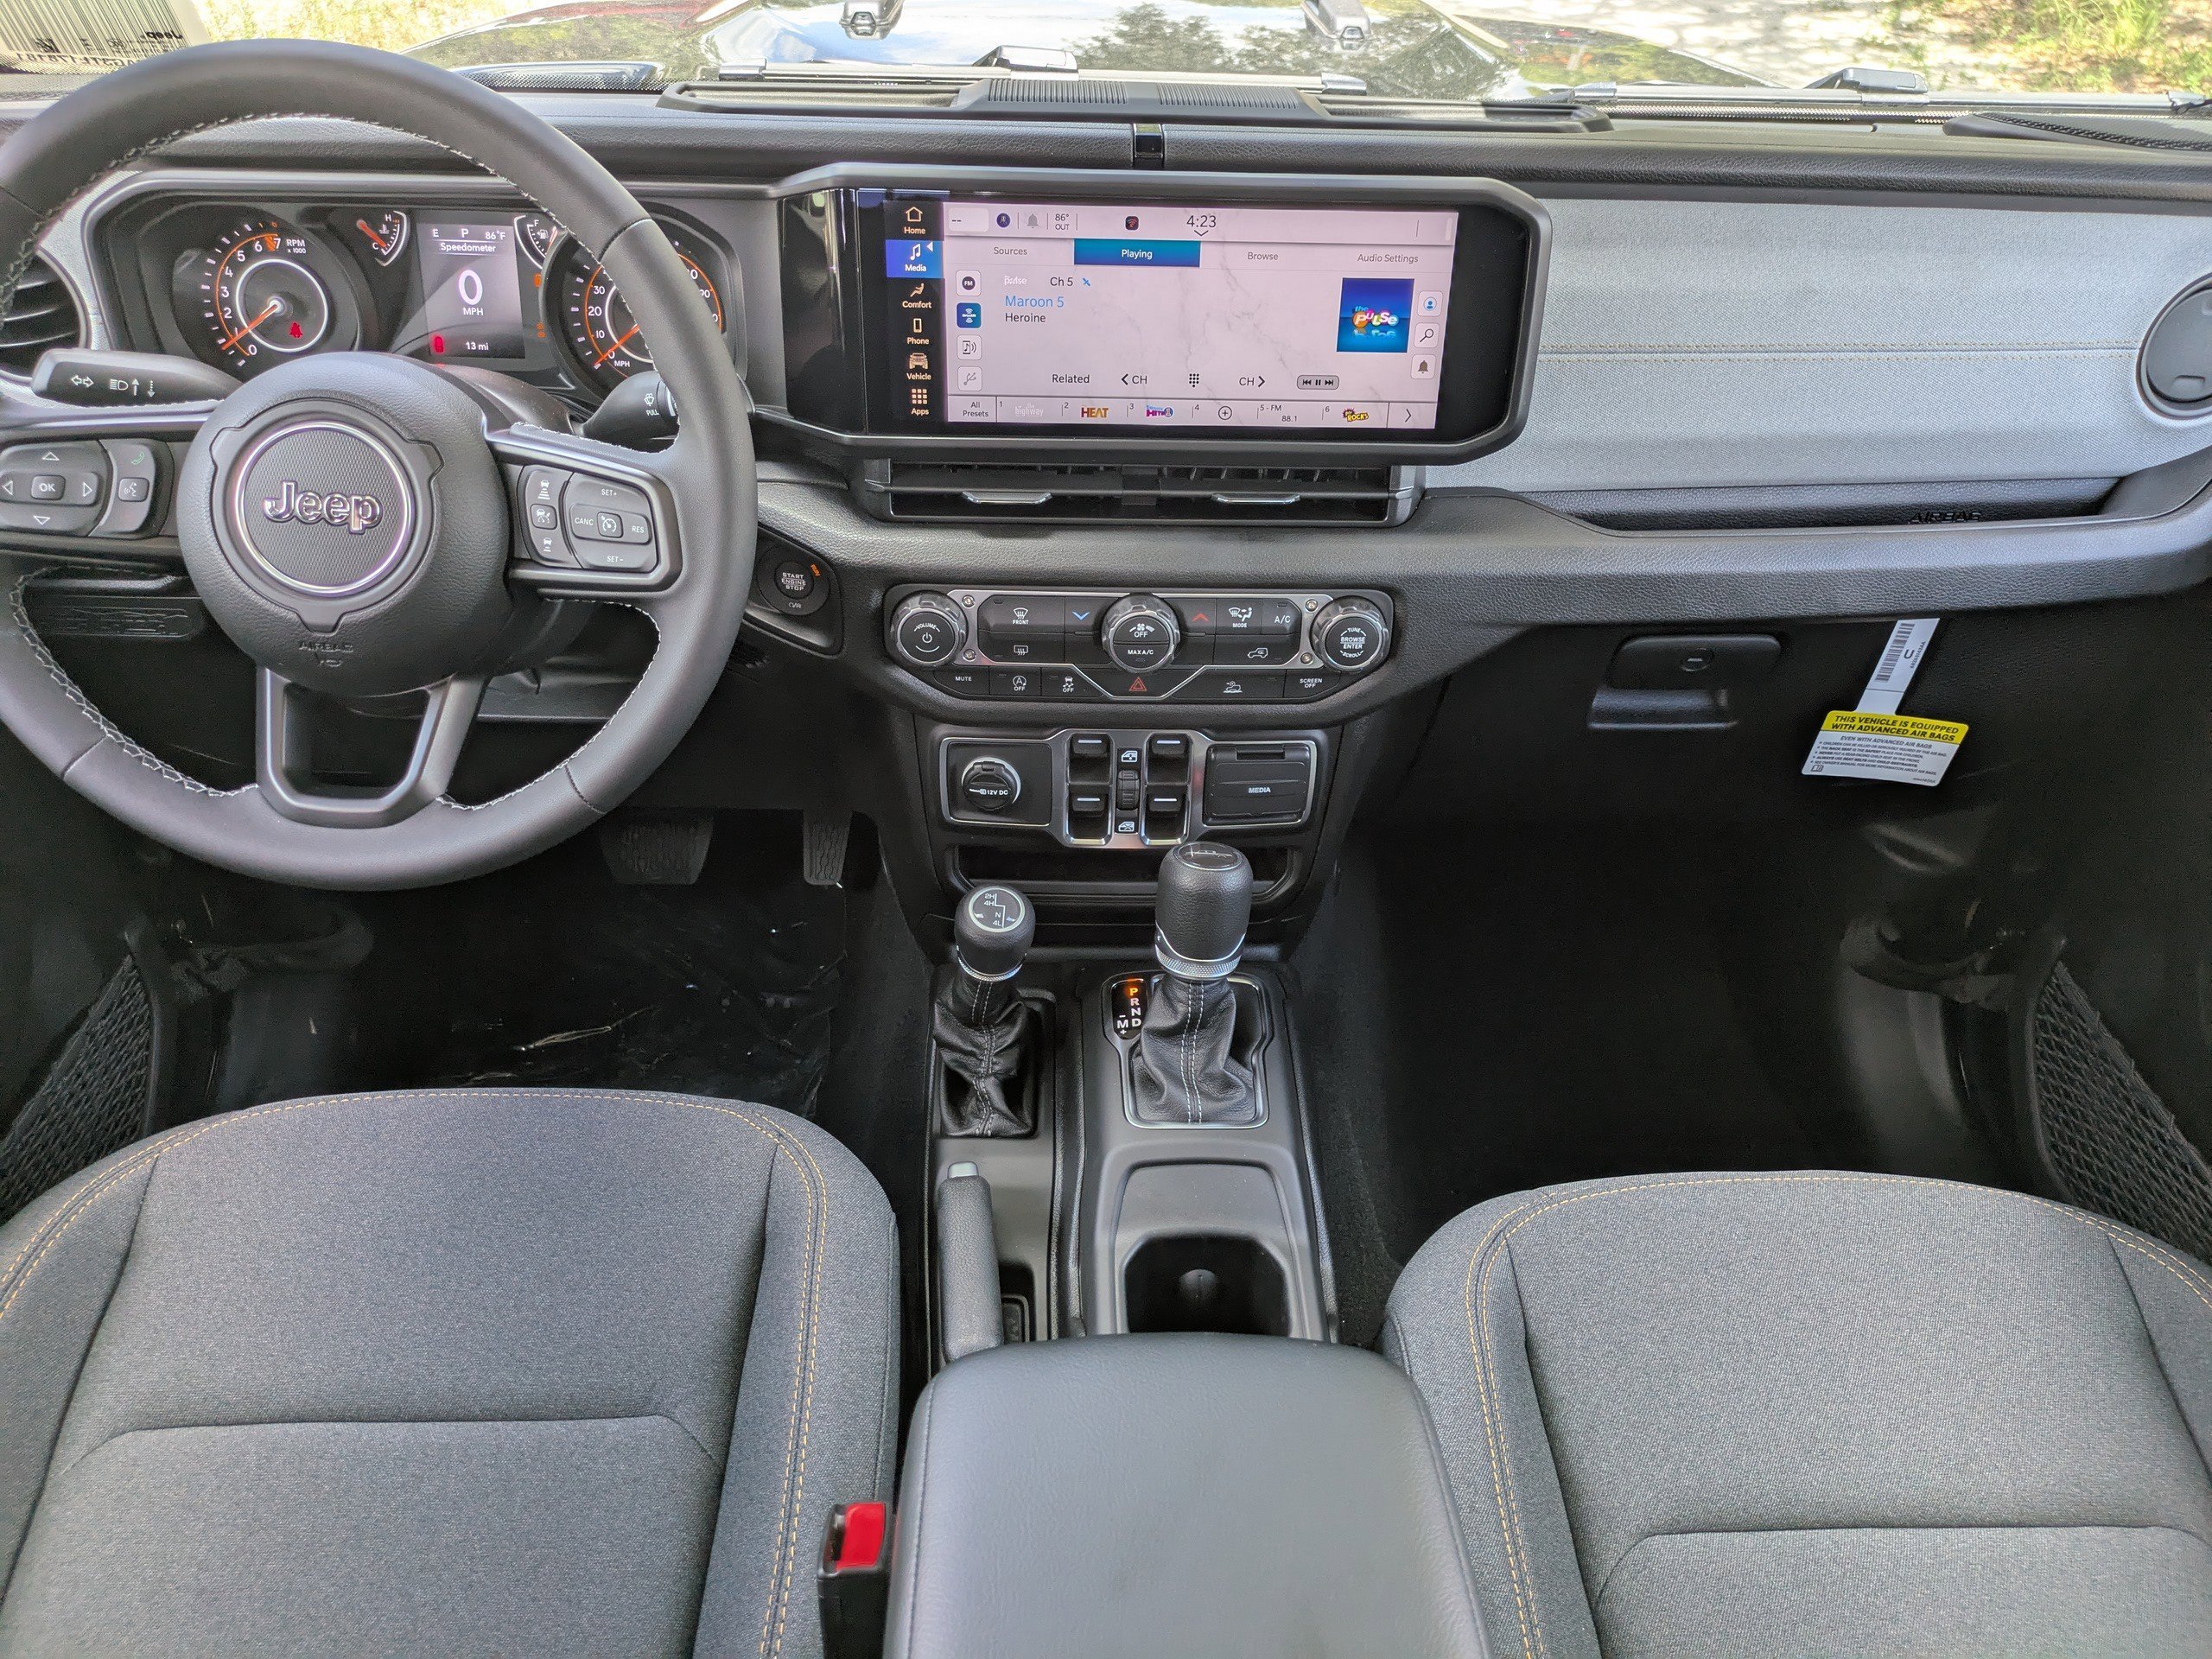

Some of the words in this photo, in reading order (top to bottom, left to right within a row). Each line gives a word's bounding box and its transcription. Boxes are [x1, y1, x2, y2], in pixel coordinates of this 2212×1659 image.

[1054, 213, 1070, 222] 86°
[1186, 215, 1217, 228] 4:23
[904, 226, 926, 235] Home
[1054, 223, 1071, 232] OUT
[432, 229, 439, 238] E
[461, 229, 469, 238] P
[254, 241, 263, 251] 6
[273, 238, 281, 249] 7
[286, 238, 306, 247] RPM
[372, 242, 378, 251] C
[440, 243, 496, 253] Speedometer
[994, 246, 1027, 256] Sources
[238, 251, 245, 261] 5
[1122, 249, 1153, 260] Playing
[1248, 251, 1279, 261] Browse
[1357, 253, 1382, 263] Audio
[1384, 254, 1419, 264] Settings
[225, 267, 233, 277] 4
[905, 264, 927, 272] Media
[1050, 276, 1064, 286] Ch
[1066, 276, 1073, 287] 5
[221, 286, 229, 297] 3
[459, 270, 483, 305] 0
[594, 286, 605, 296] 30
[902, 301, 932, 309] Comfort
[1005, 295, 1053, 308] Maroon
[1057, 296, 1065, 308] 5
[223, 308, 232, 319] 2
[463, 308, 484, 316] MPH
[588, 306, 602, 316] 20
[1005, 313, 1046, 323] Heroine
[596, 330, 605, 339] 10
[466, 341, 476, 350] 13
[478, 342, 489, 351] mi
[906, 337, 930, 346] Phone
[248, 345, 257, 355] 0
[607, 350, 615, 359] 0
[1052, 373, 1090, 384] Related
[1132, 375, 1147, 385] CH
[1239, 377, 1255, 386] CH
[911, 408, 929, 416] Apps
[963, 410, 988, 418] Presets
[1081, 407, 1109, 418] HEAT
[39, 482, 56, 493] OK
[263, 480, 382, 534] Jeep
[575, 517, 594, 526] CANC
[1274, 615, 1291, 624] A/C
[1904, 649, 1915, 659] U
[1859, 717, 1897, 727] VEHICLE
[1910, 721, 1959, 734] EQUIPPED
[1858, 725, 1909, 735] ADVANCED
[1929, 732, 1955, 741] BAGS
[1248, 785, 1271, 794] MEDIA
[1129, 988, 1138, 996] P
[1130, 997, 1140, 1006] R
[1131, 1007, 1141, 1016] N
[1116, 1020, 1128, 1029] M
[1132, 1018, 1141, 1027] D
